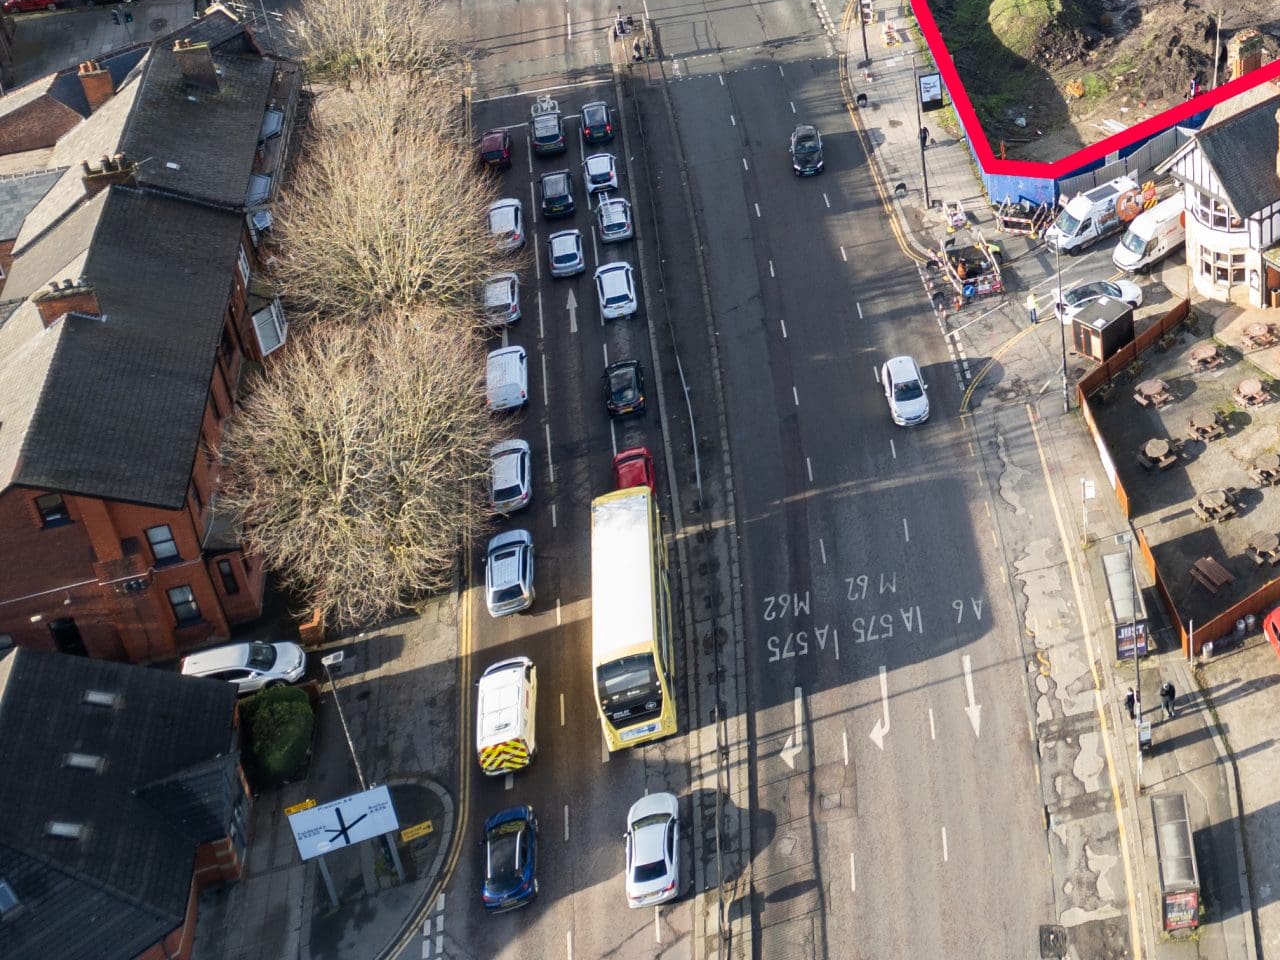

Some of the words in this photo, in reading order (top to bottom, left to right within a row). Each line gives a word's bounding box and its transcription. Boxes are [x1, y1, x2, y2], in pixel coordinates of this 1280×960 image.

[845, 572, 897, 600] M62
[763, 591, 810, 621] M62
[952, 598, 983, 623] A6
